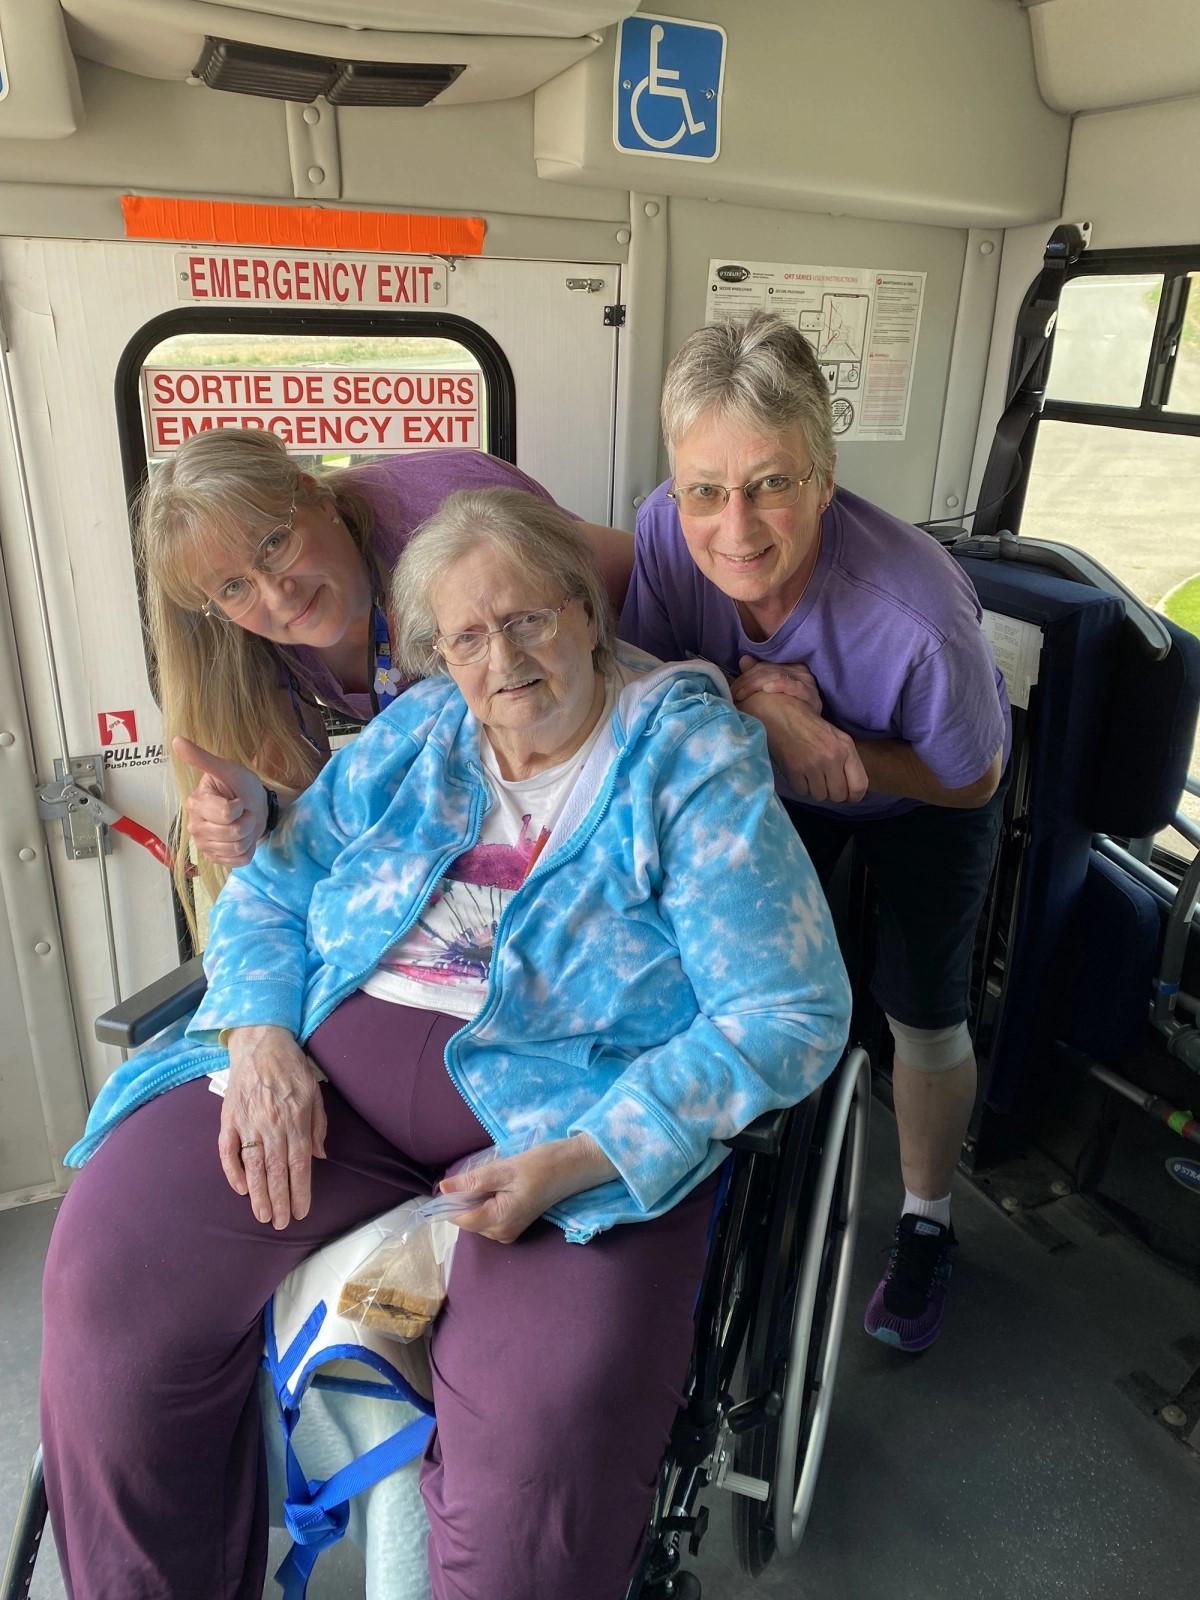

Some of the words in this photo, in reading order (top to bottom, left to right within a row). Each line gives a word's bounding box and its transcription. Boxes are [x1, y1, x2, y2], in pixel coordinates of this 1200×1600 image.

[189, 257, 367, 302] EMERGENCY
[377, 265, 434, 304] EXIT
[795, 273, 812, 281] SERIES
[153, 374, 273, 404] SORTIE
[283, 375, 323, 404] DE
[333, 376, 474, 405] SECOURS
[403, 416, 475, 443] EXIT
[109, 720, 121, 729] OPEN
[104, 747, 141, 763] PULL
[146, 744, 166, 758] HA
[130, 759, 151, 767] Door
